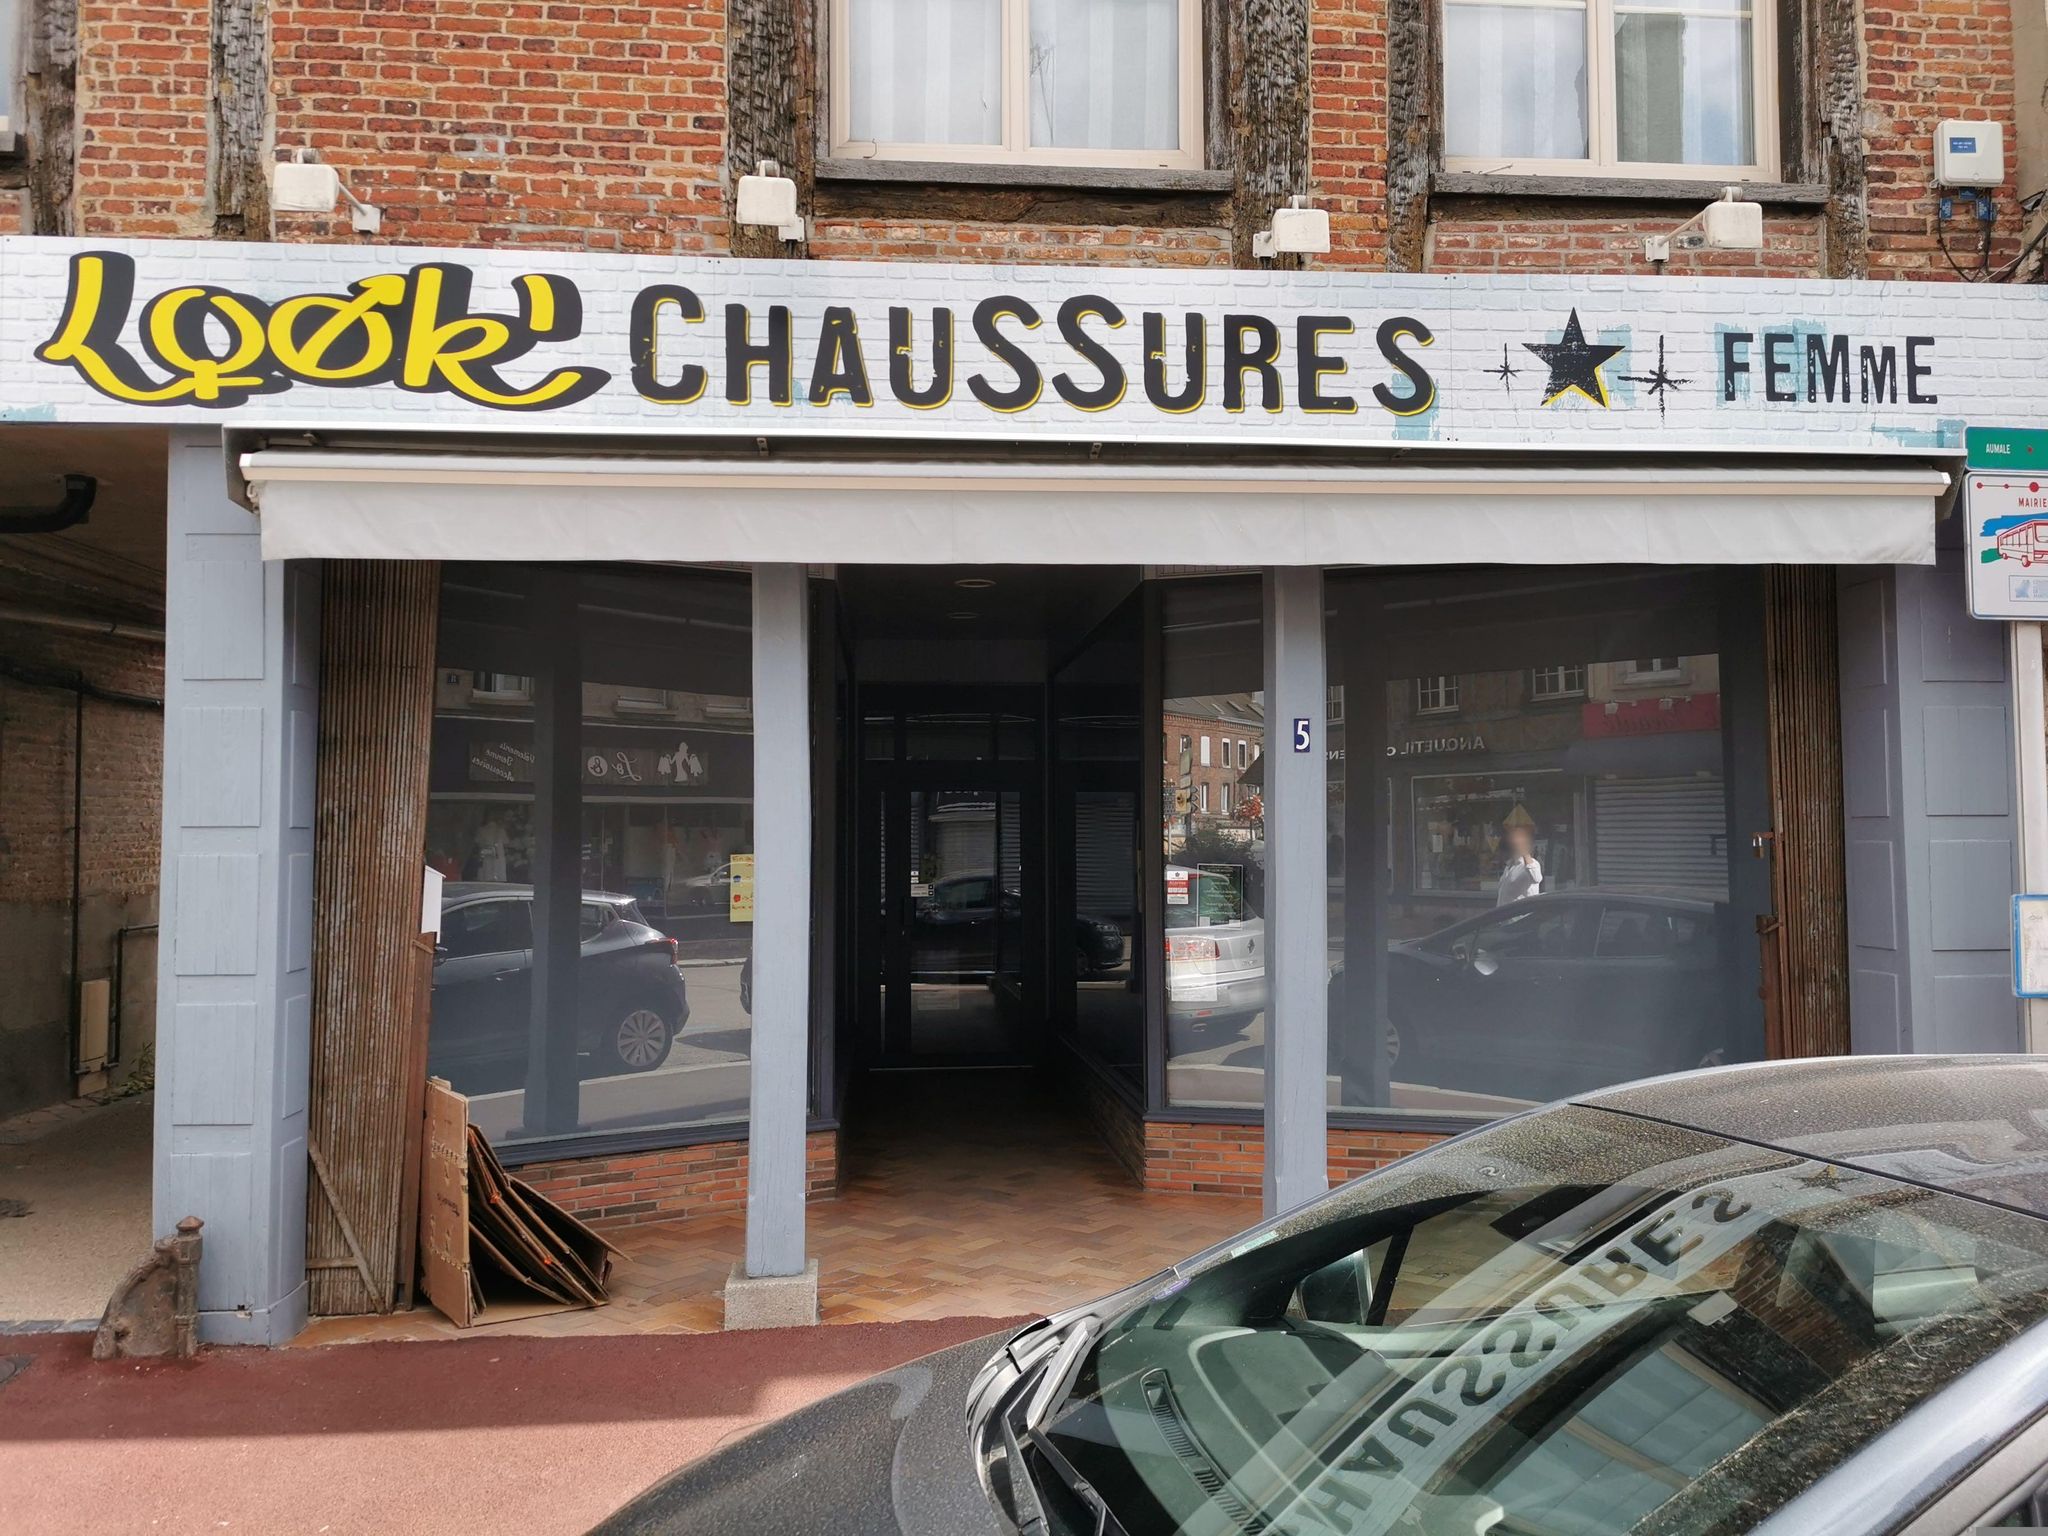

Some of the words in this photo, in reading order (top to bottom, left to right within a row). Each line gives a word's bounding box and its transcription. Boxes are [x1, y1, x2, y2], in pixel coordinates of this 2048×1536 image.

[629, 283, 1436, 416] CHAUSSURES
[1724, 332, 1938, 405] FEMME
[1985, 443, 2011, 454] AUMALE
[2018, 497, 2048, 508] MAIRIE
[1295, 720, 1310, 751] 5
